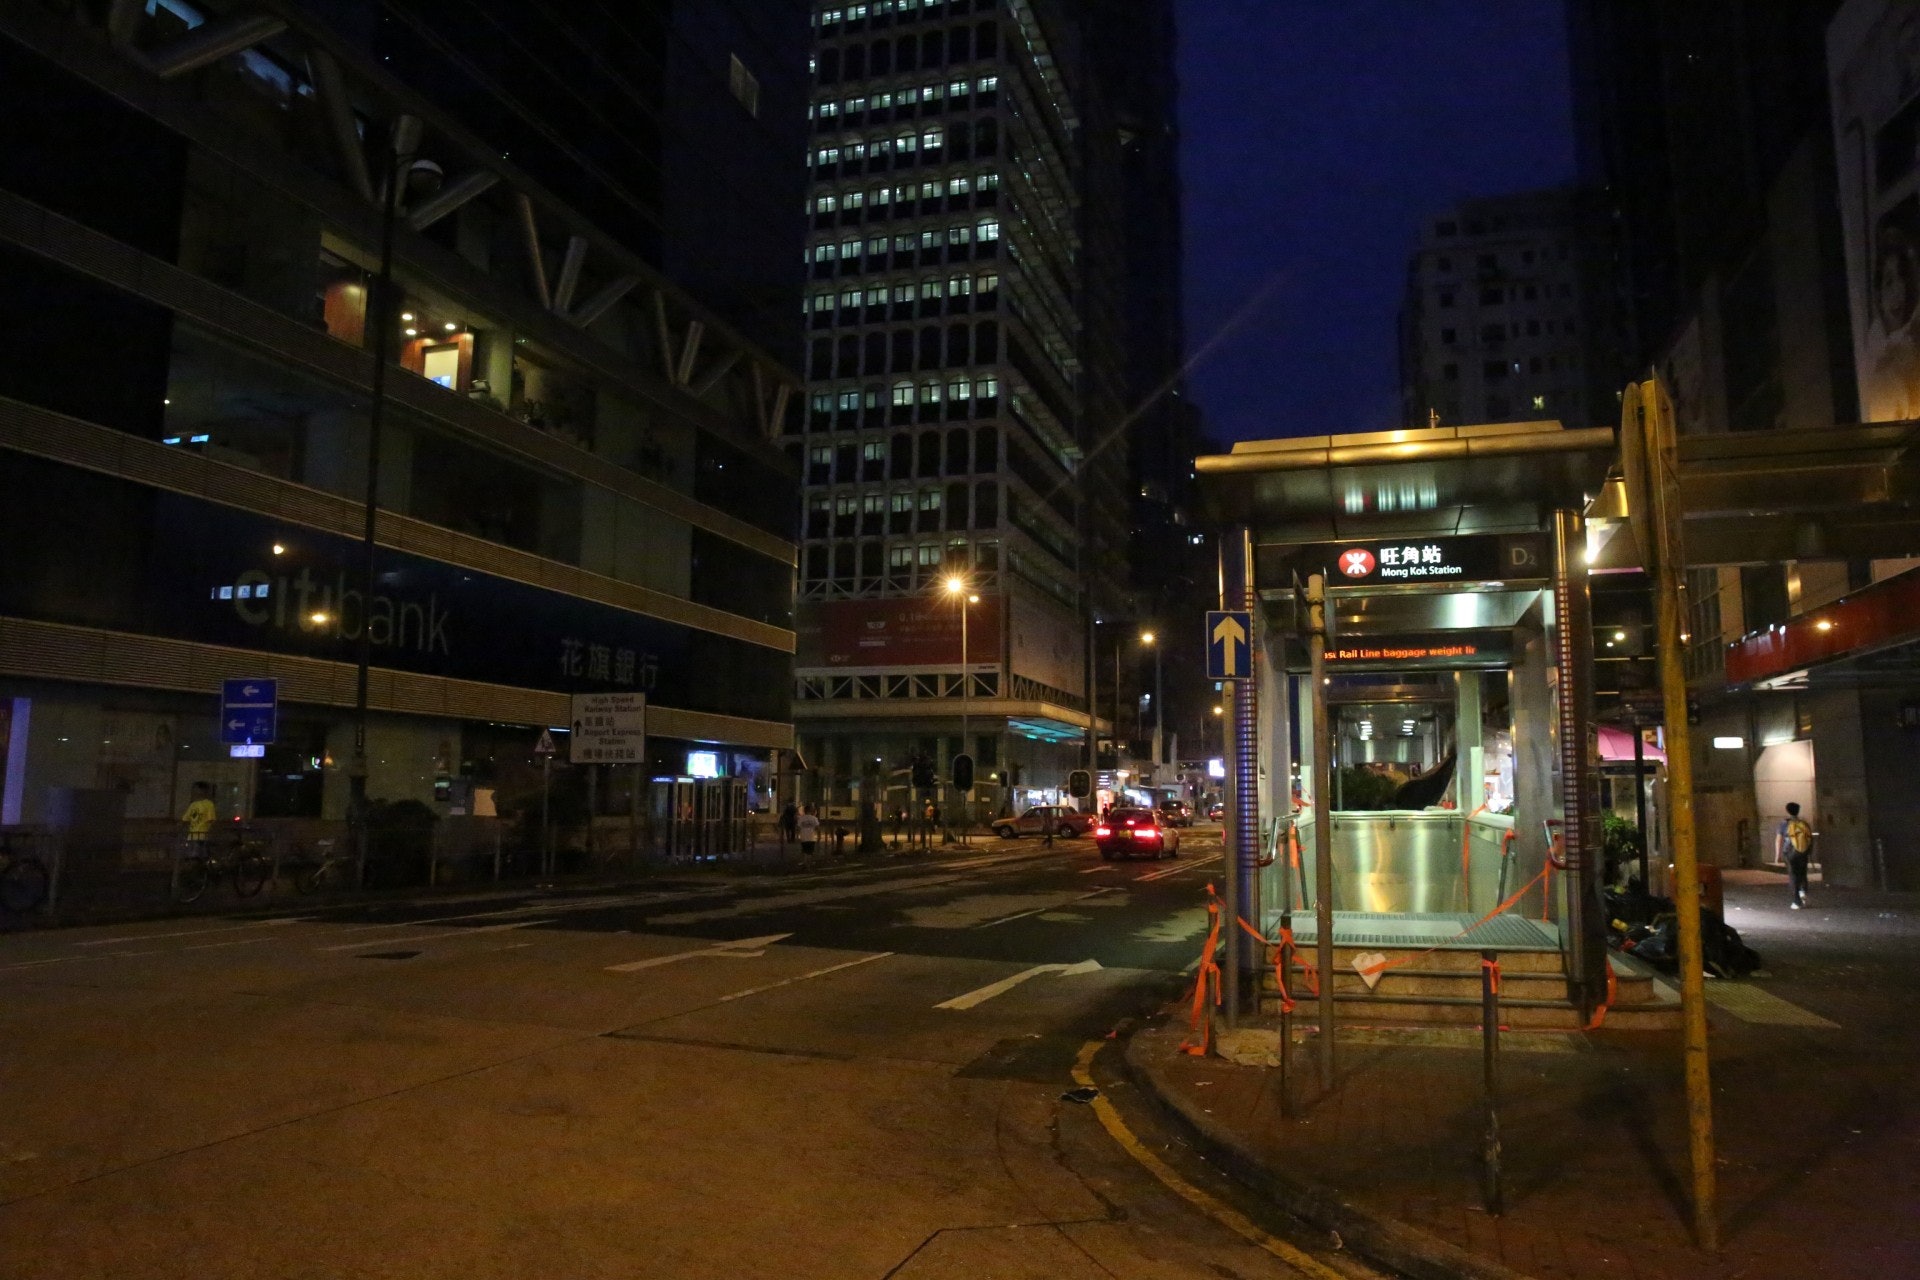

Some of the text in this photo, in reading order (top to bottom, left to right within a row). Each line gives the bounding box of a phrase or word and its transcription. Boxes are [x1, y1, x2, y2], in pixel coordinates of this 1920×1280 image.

[1380, 545, 1442, 565] 旺角站
[1381, 565, 1462, 578] Mong Kok Station
[1339, 649, 1358, 659] Rail
[1360, 648, 1381, 659] Line
[1383, 647, 1426, 659] baggage
[1429, 646, 1463, 657] weight
[560, 637, 659, 688] 花旗銀行
[613, 729, 641, 737] Express
